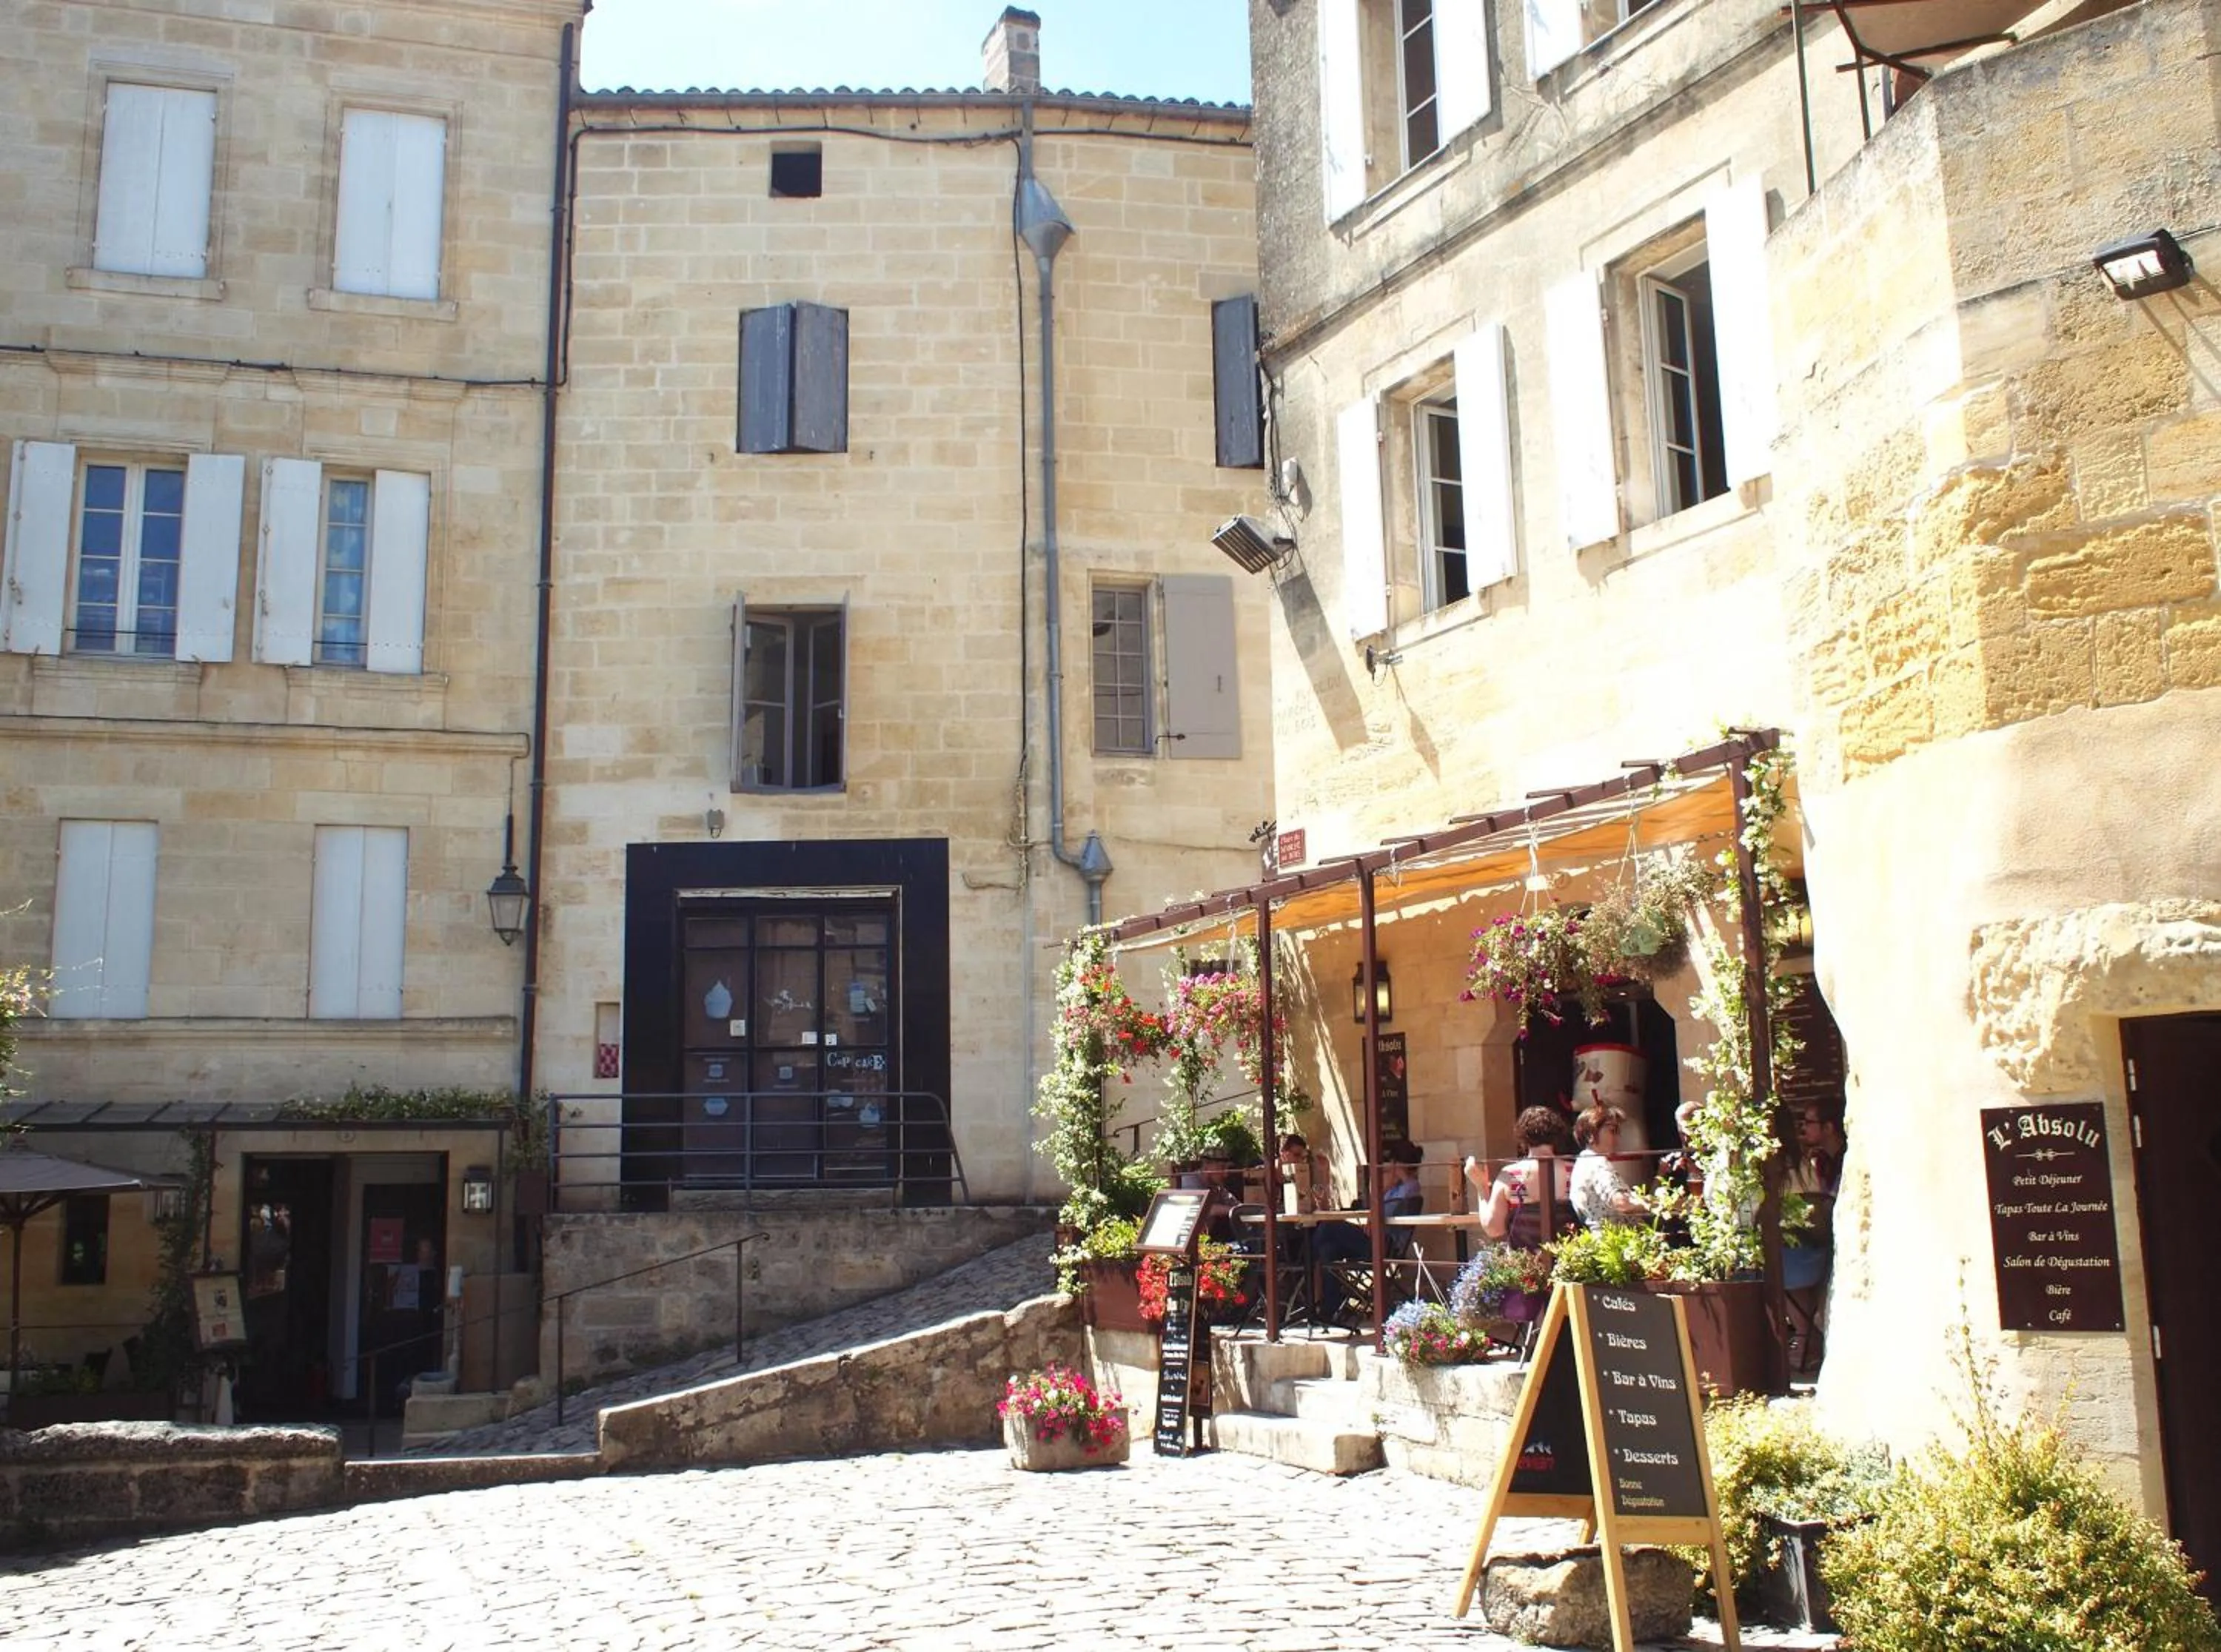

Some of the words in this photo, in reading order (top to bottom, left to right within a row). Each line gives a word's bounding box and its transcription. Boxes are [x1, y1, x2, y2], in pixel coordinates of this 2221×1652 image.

[1987, 1113, 2100, 1151] L'Absolu
[2012, 1173, 2036, 1186] Petit
[2039, 1173, 2083, 1188] Déjeuner
[1994, 1203, 2023, 1217] Tapas
[2024, 1202, 2051, 1214] Toute
[2054, 1201, 2068, 1213] La
[2070, 1200, 2108, 1214] Journée
[2028, 1231, 2047, 1241] Bar
[2049, 1232, 2054, 1241] à
[2056, 1229, 2080, 1241] Vins
[2003, 1255, 2031, 1267] Salon
[2034, 1255, 2046, 1267] de
[2047, 1256, 2110, 1270] Dégustation
[2046, 1284, 2071, 1295] Bière
[1602, 1295, 1636, 1312] Cafés
[2049, 1309, 2072, 1323] Café
[1607, 1333, 1647, 1349] Bières
[1612, 1370, 1635, 1386] Bar
[1638, 1373, 1647, 1387] à
[1647, 1374, 1677, 1389] Vins
[1617, 1409, 1657, 1428] Tapas
[1622, 1448, 1679, 1465] Desserts
